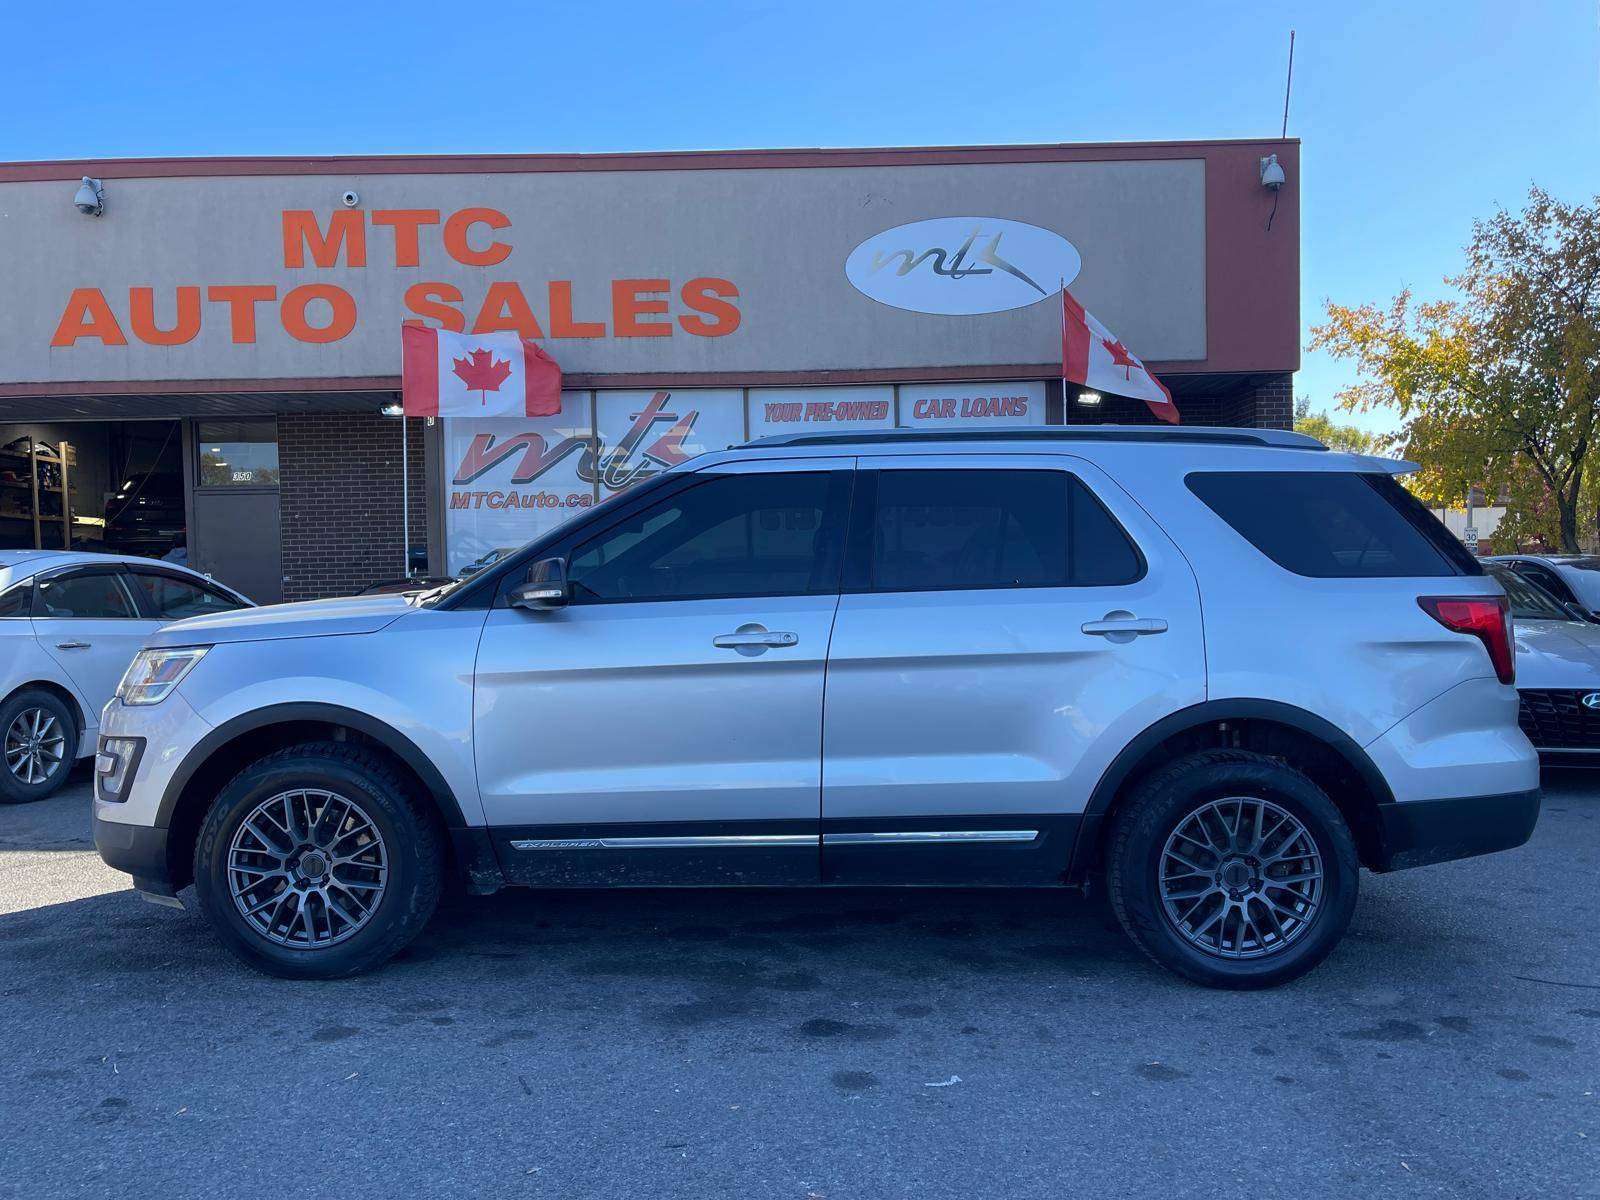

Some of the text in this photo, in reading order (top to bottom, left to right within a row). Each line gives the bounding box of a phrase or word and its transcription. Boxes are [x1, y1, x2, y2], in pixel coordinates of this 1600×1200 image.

[282, 208, 513, 268] MTC
[50, 277, 741, 346] AUTO SALES
[764, 400, 889, 423] YOUR PRE-OWNED
[912, 396, 1028, 418] CAR LOANS
[449, 491, 593, 510] MTCAuto.ca
[1466, 533, 1477, 542] 30
